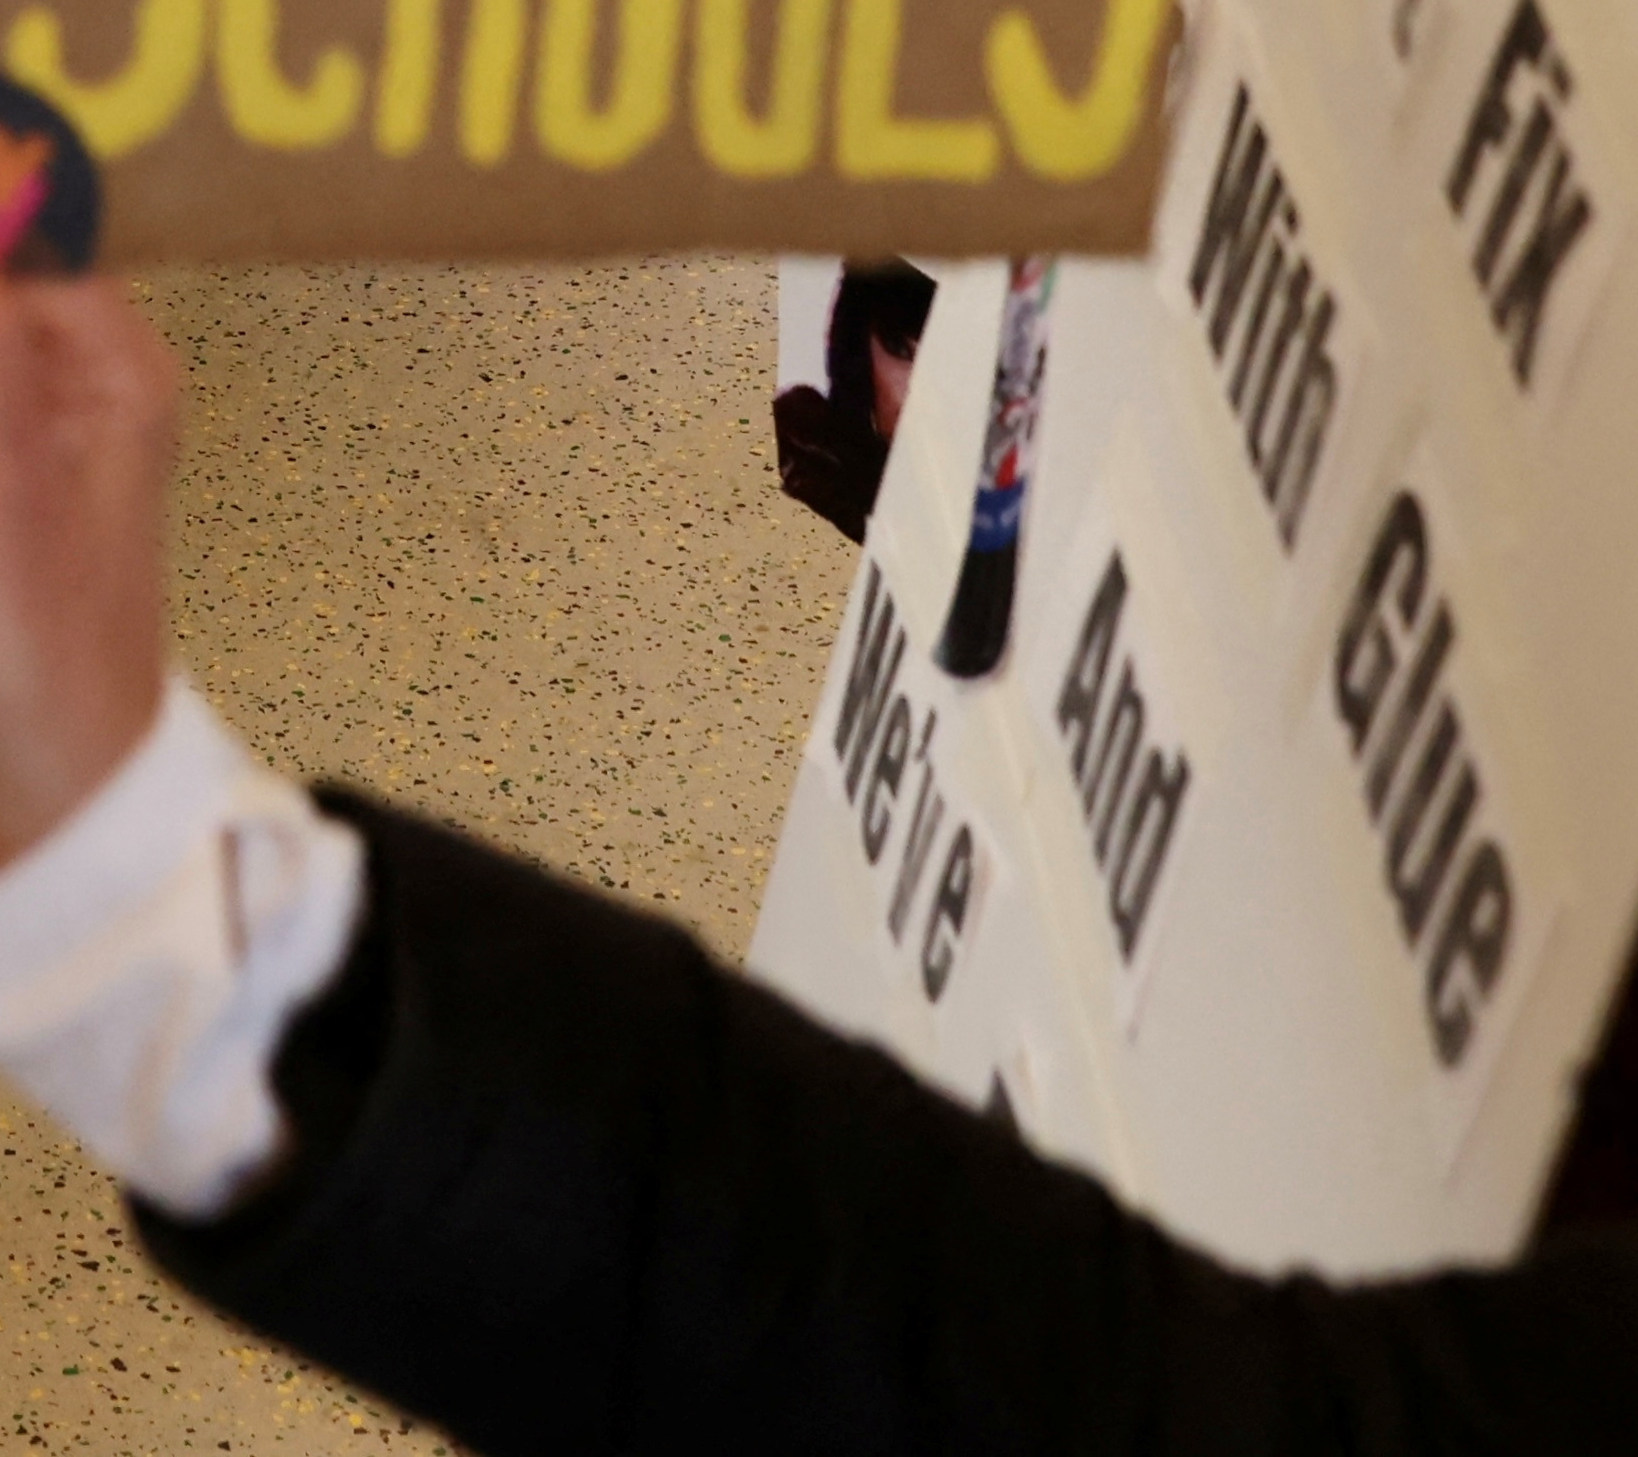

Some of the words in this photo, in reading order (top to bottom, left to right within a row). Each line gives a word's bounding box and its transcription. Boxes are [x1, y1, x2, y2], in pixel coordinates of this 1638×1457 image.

[830, 553, 977, 1005] We've
[1054, 545, 1192, 967] And
[1186, 77, 1340, 557] With
[1333, 487, 1515, 1072] Glue
